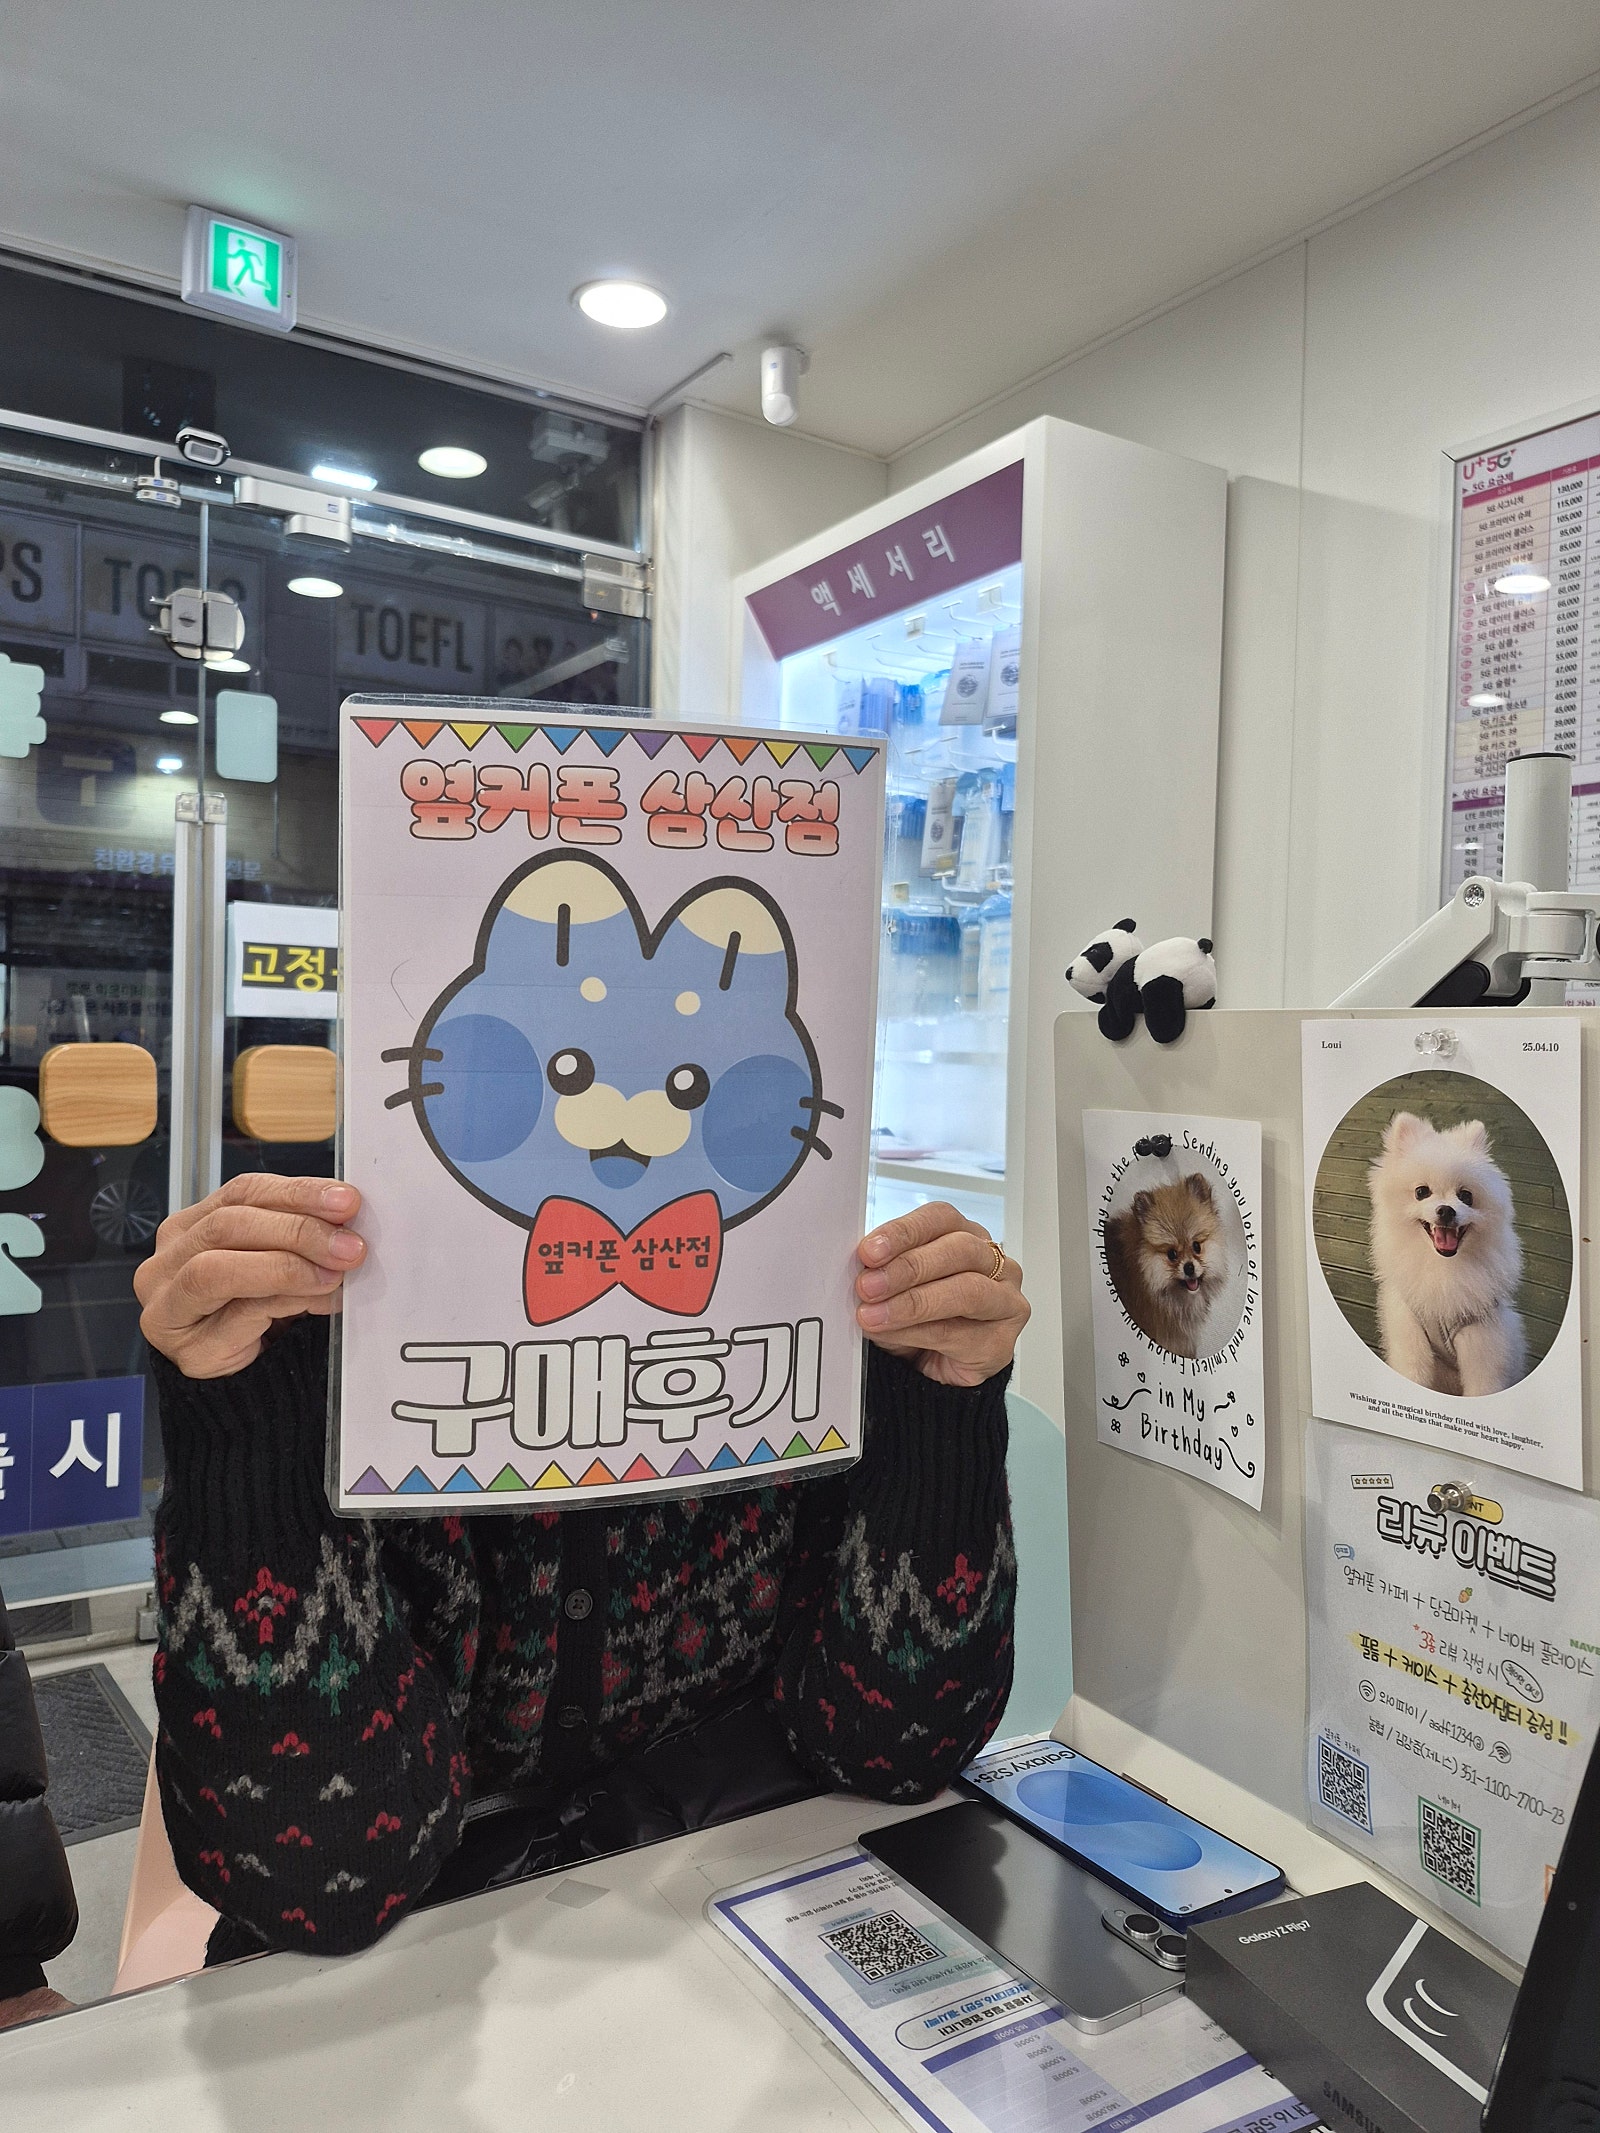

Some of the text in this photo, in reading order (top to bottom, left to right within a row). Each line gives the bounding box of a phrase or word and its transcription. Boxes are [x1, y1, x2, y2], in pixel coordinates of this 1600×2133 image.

[811, 525, 956, 616] 액세서리
[350, 602, 474, 674] TOEFL
[401, 758, 841, 857] 옆커폰 삼산점
[242, 945, 338, 993] 고정
[1321, 1041, 1342, 1050] Loui
[1522, 1042, 1560, 1053] 25.04.10
[1110, 1157, 1130, 1182] the
[1182, 1129, 1229, 1177] Sending
[1101, 1185, 1114, 1203] to
[1227, 1177, 1246, 1206] you
[1092, 1208, 1110, 1238] day
[1241, 1211, 1256, 1250] lots
[538, 1232, 712, 1273] 옆커폰 삼산점
[1247, 1259, 1259, 1281] of
[1120, 1310, 1143, 1341] your
[1243, 1288, 1259, 1325] love
[1147, 1339, 1185, 1375] Enjoy
[1191, 1348, 1229, 1377] smiles!
[1228, 1328, 1245, 1363] and
[391, 1315, 822, 1457] 구매후기
[1159, 1381, 1205, 1422] in My
[1349, 1391, 1377, 1406] Wishing
[1378, 1399, 1390, 1409] you
[1397, 1402, 1424, 1416] magical
[1424, 1408, 1454, 1424] birthday
[1455, 1416, 1474, 1429] filled
[1475, 1422, 1492, 1433] with
[1367, 1404, 1380, 1413] and
[1381, 1406, 1391, 1415] all
[1392, 1409, 1404, 1418] the
[1404, 1411, 1427, 1425] things
[1428, 1417, 1442, 1428] that
[1443, 1421, 1463, 1433] make
[1463, 1428, 1480, 1440] your
[1480, 1431, 1500, 1444] heart
[1141, 1412, 1223, 1471] Birthday
[1377, 1495, 1557, 1604] 리뷰 이벤트
[1343, 1565, 1375, 1593] 옆커폰
[1379, 1579, 1409, 1603] 카페
[1430, 1596, 1478, 1637] 당근마켓
[1498, 1627, 1535, 1657] 네이버
[1539, 1640, 1595, 1677] 플레이스
[1439, 1639, 1458, 1663] 리뷰
[1462, 1648, 1484, 1675] 작성
[1487, 1663, 1499, 1681] 시
[1359, 1633, 1380, 1663] 필름
[1401, 1655, 1439, 1685] 케이스
[1526, 1708, 1554, 1743] 증정
[1378, 1691, 1418, 1720] 와이파이
[1429, 1718, 1485, 1752] asdf1234@
[973, 1765, 1013, 1786] S25+
[1010, 1749, 1077, 1774] Galaxy
[1238, 1919, 1312, 1946] Galaxy Z Flip7
[1002, 1993, 1033, 2011] 사용할
[936, 2012, 984, 2036] 없습니다!
[1323, 2081, 1385, 2133] SAMSU
